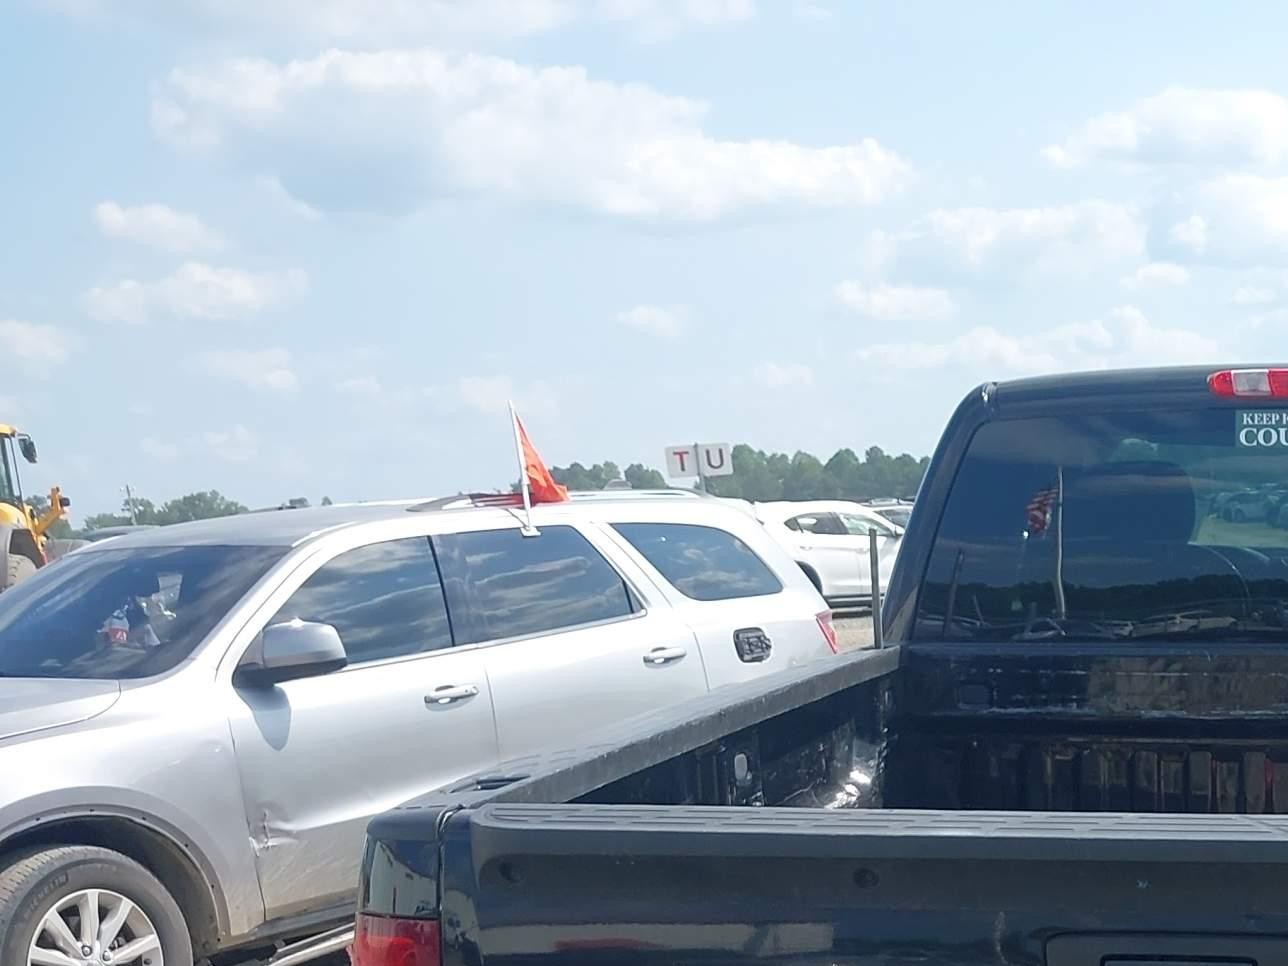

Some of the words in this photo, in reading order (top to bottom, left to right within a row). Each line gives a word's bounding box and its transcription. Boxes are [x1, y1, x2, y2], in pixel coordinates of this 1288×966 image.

[1242, 412, 1280, 425] KEEP
[672, 450, 690, 472] T
[705, 448, 725, 470] U
